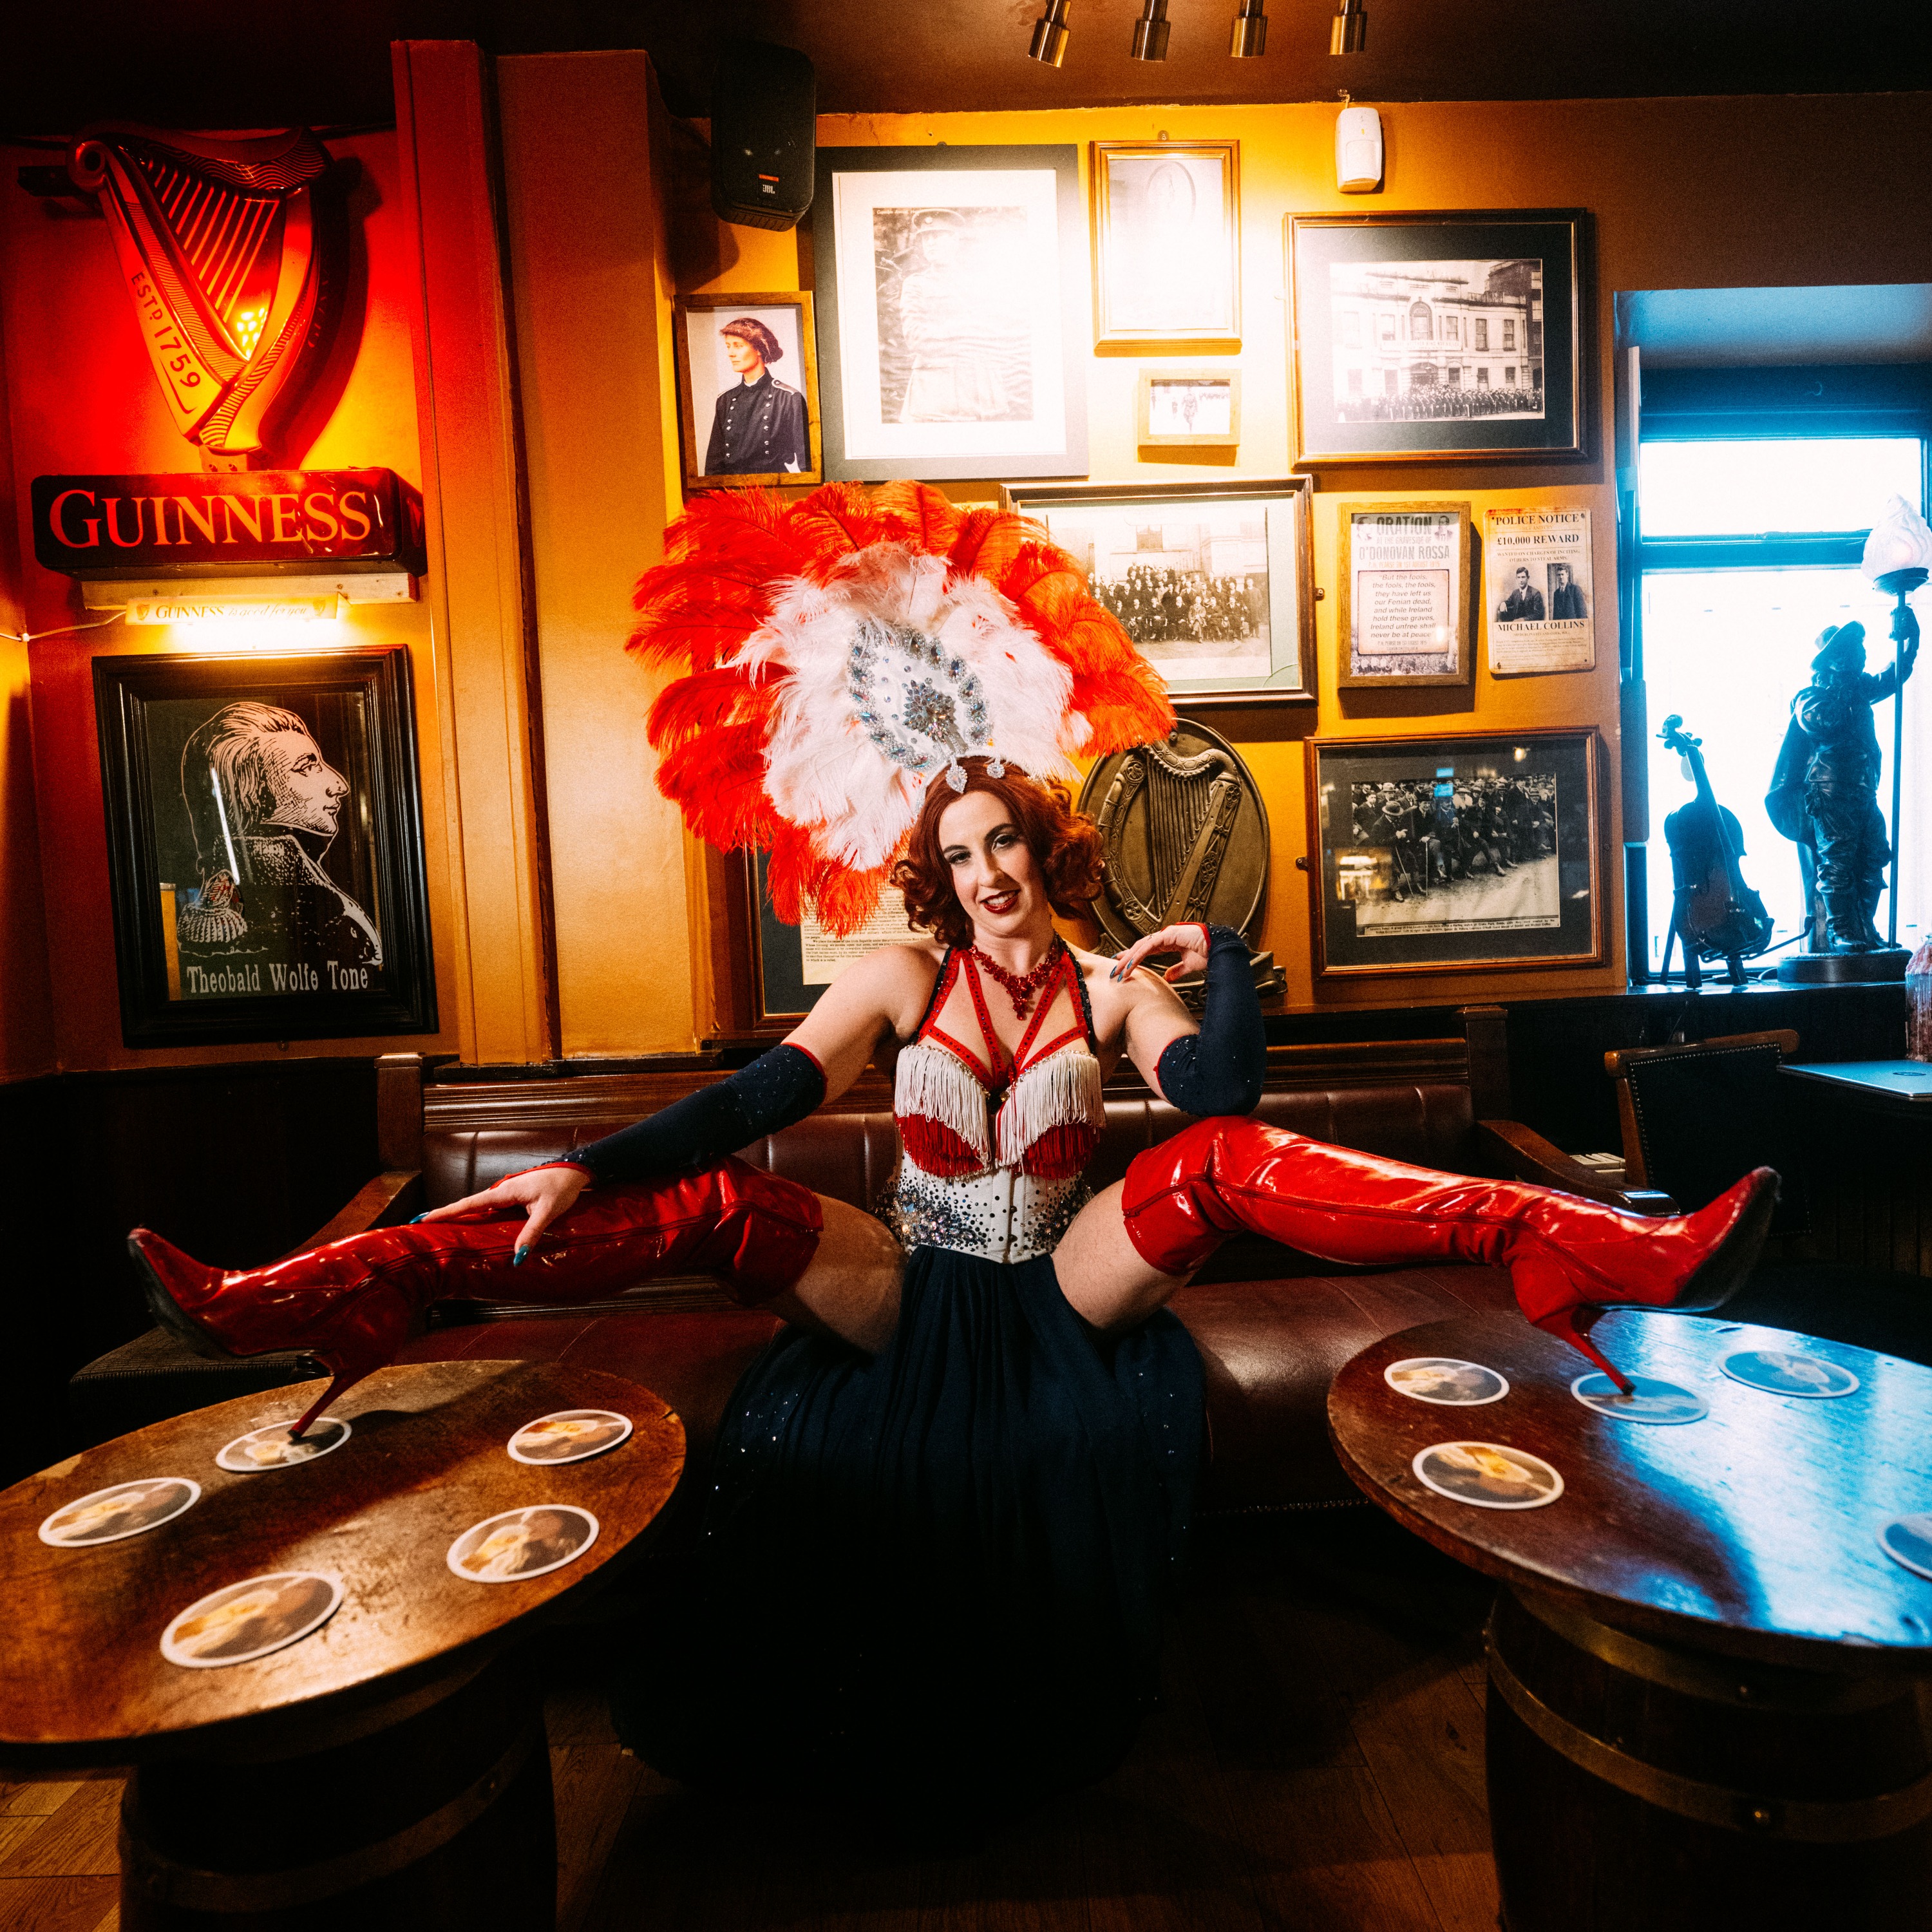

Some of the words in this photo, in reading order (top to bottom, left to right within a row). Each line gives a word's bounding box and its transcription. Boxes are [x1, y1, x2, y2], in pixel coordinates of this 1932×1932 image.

[762, 184, 775, 194] JBL
[154, 325, 201, 388] 1759
[49, 489, 371, 549] GUINNESS
[1376, 516, 1432, 535] ORATION
[1496, 515, 1536, 526] POLICE
[1539, 513, 1579, 524] NOTICE
[1396, 536, 1424, 544] GRAVESIDE
[1497, 536, 1531, 545] £10,000
[1533, 534, 1580, 544] REWARD
[1359, 546, 1414, 560] O'DONOVAN
[1418, 545, 1450, 560] ROSSA
[155, 605, 225, 619] GUINNESS
[228, 607, 238, 616] is
[240, 605, 270, 617] good
[269, 603, 287, 619] for
[287, 607, 308, 618] you
[1498, 623, 1542, 632] MICHAEL
[1544, 620, 1585, 630] COLLINS
[186, 964, 261, 993] Theobald
[269, 963, 319, 992] Wolfe
[327, 960, 368, 990] Tone
